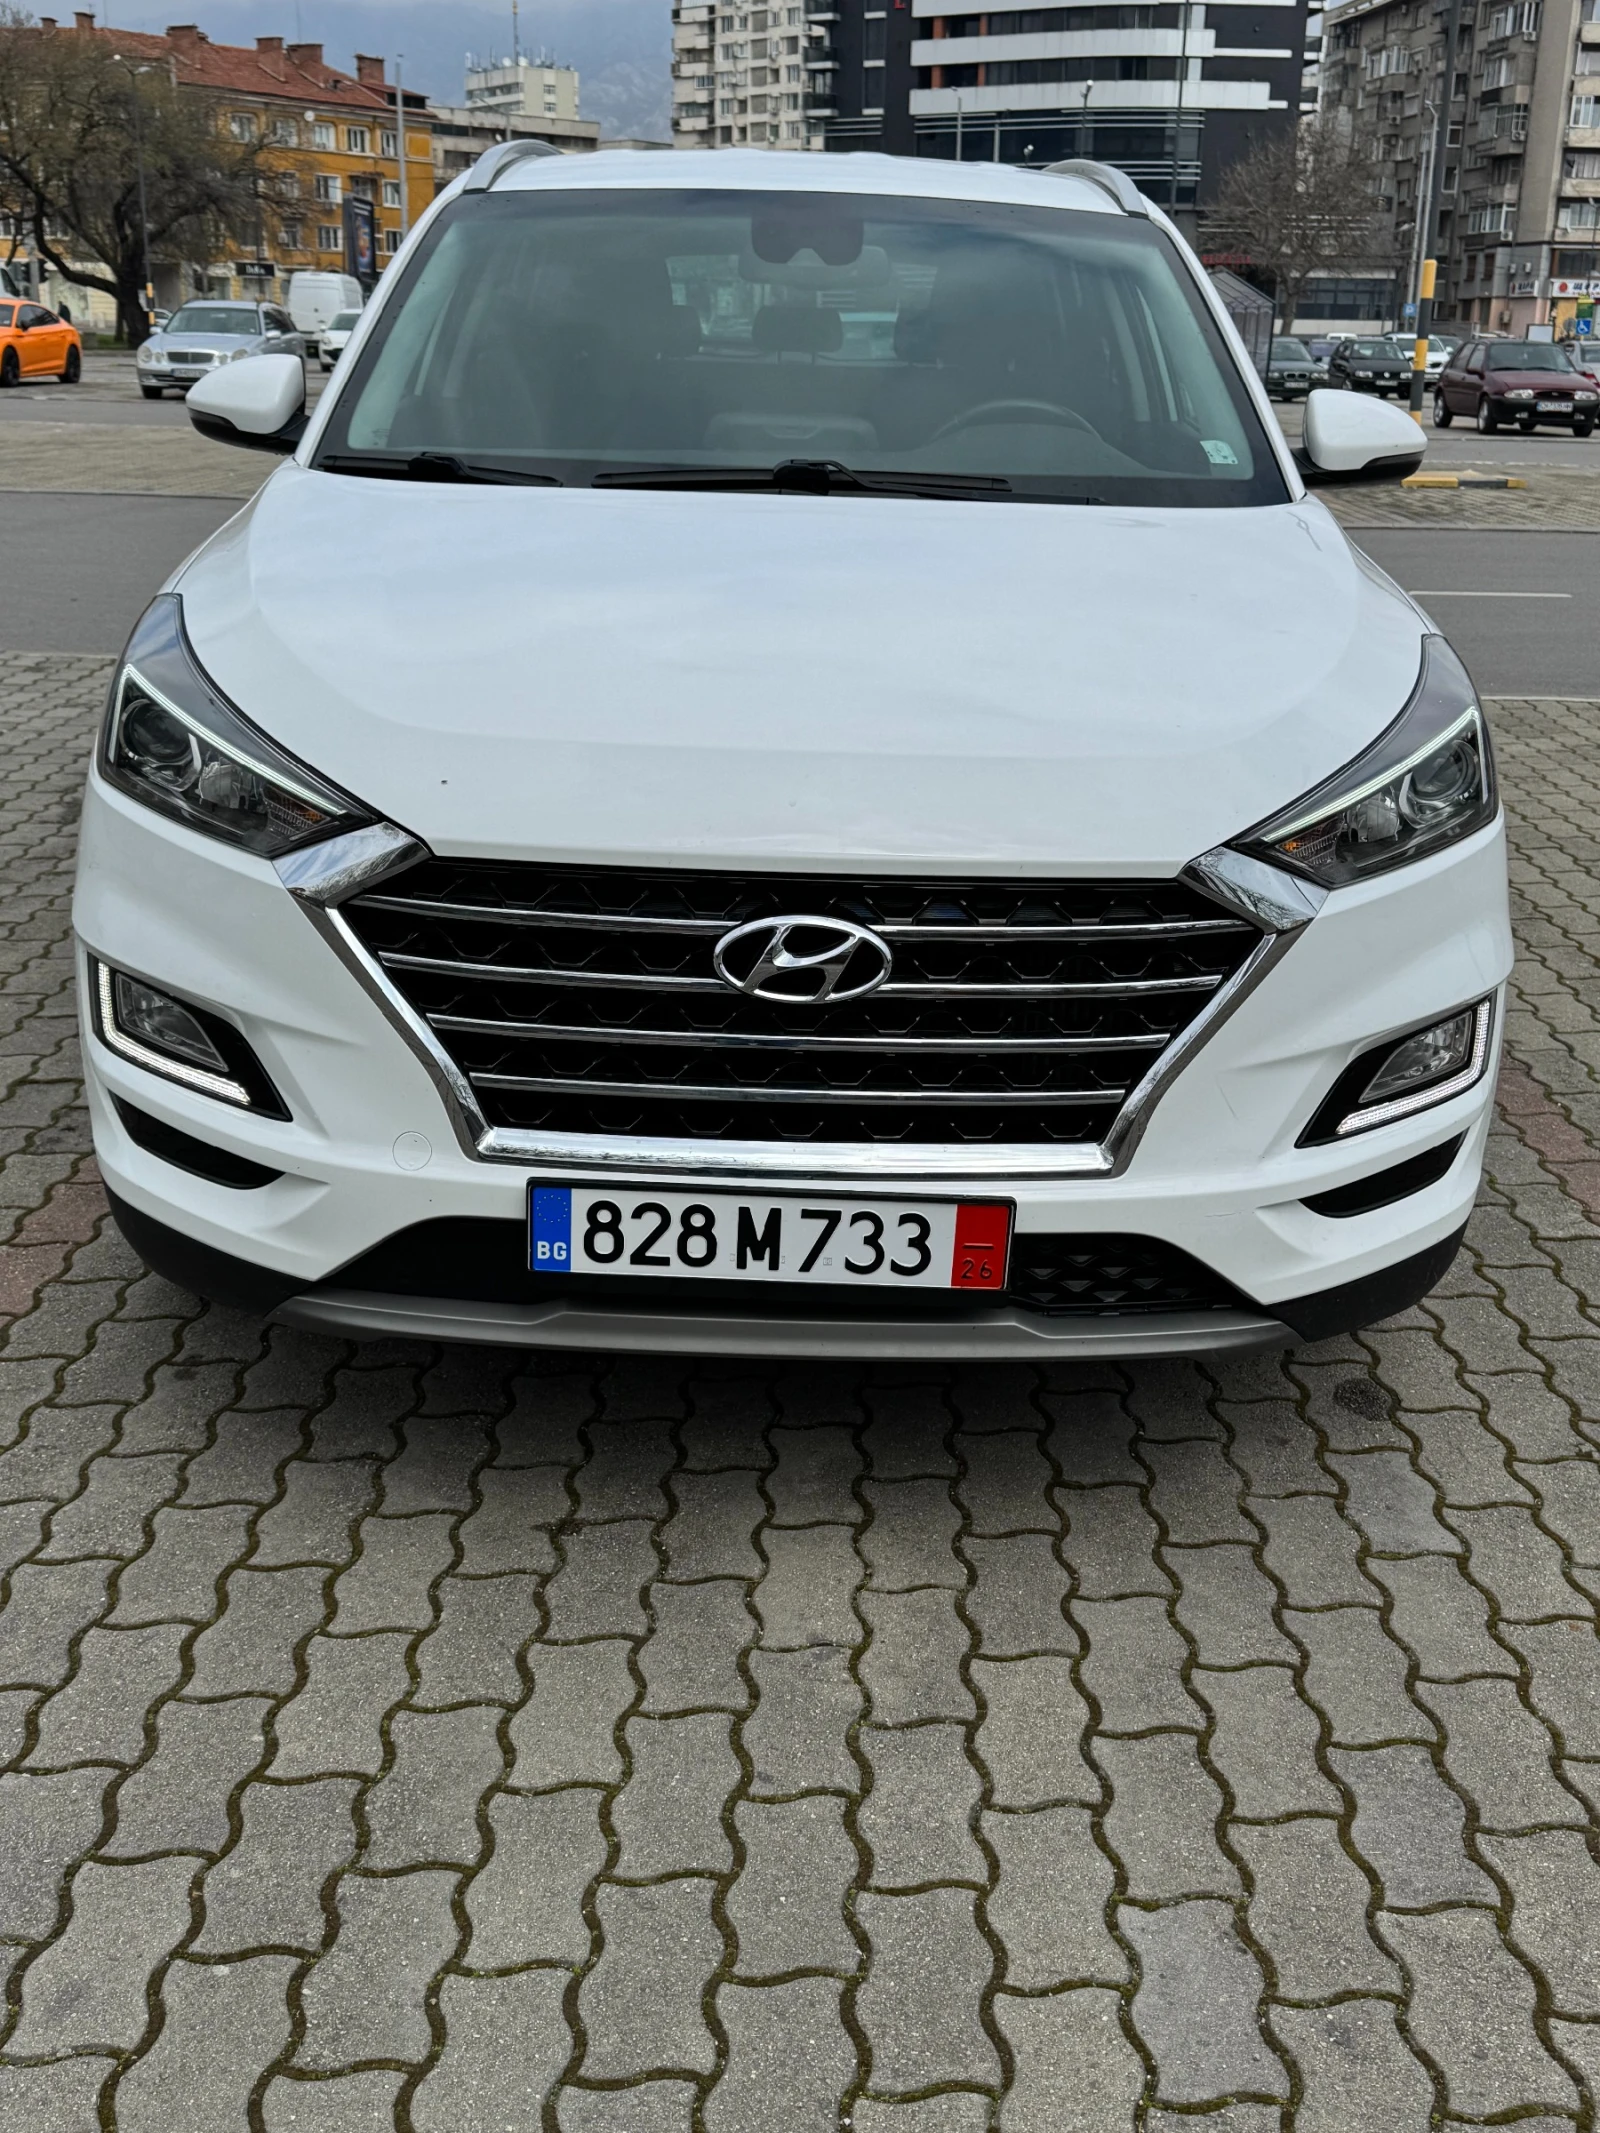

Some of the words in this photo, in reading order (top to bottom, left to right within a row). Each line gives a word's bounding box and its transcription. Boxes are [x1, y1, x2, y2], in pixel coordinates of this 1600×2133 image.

[583, 1200, 717, 1267] 828
[736, 1206, 782, 1270] M
[798, 1208, 932, 1276] 733
[537, 1241, 567, 1260] BG
[961, 1257, 993, 1280] 26
